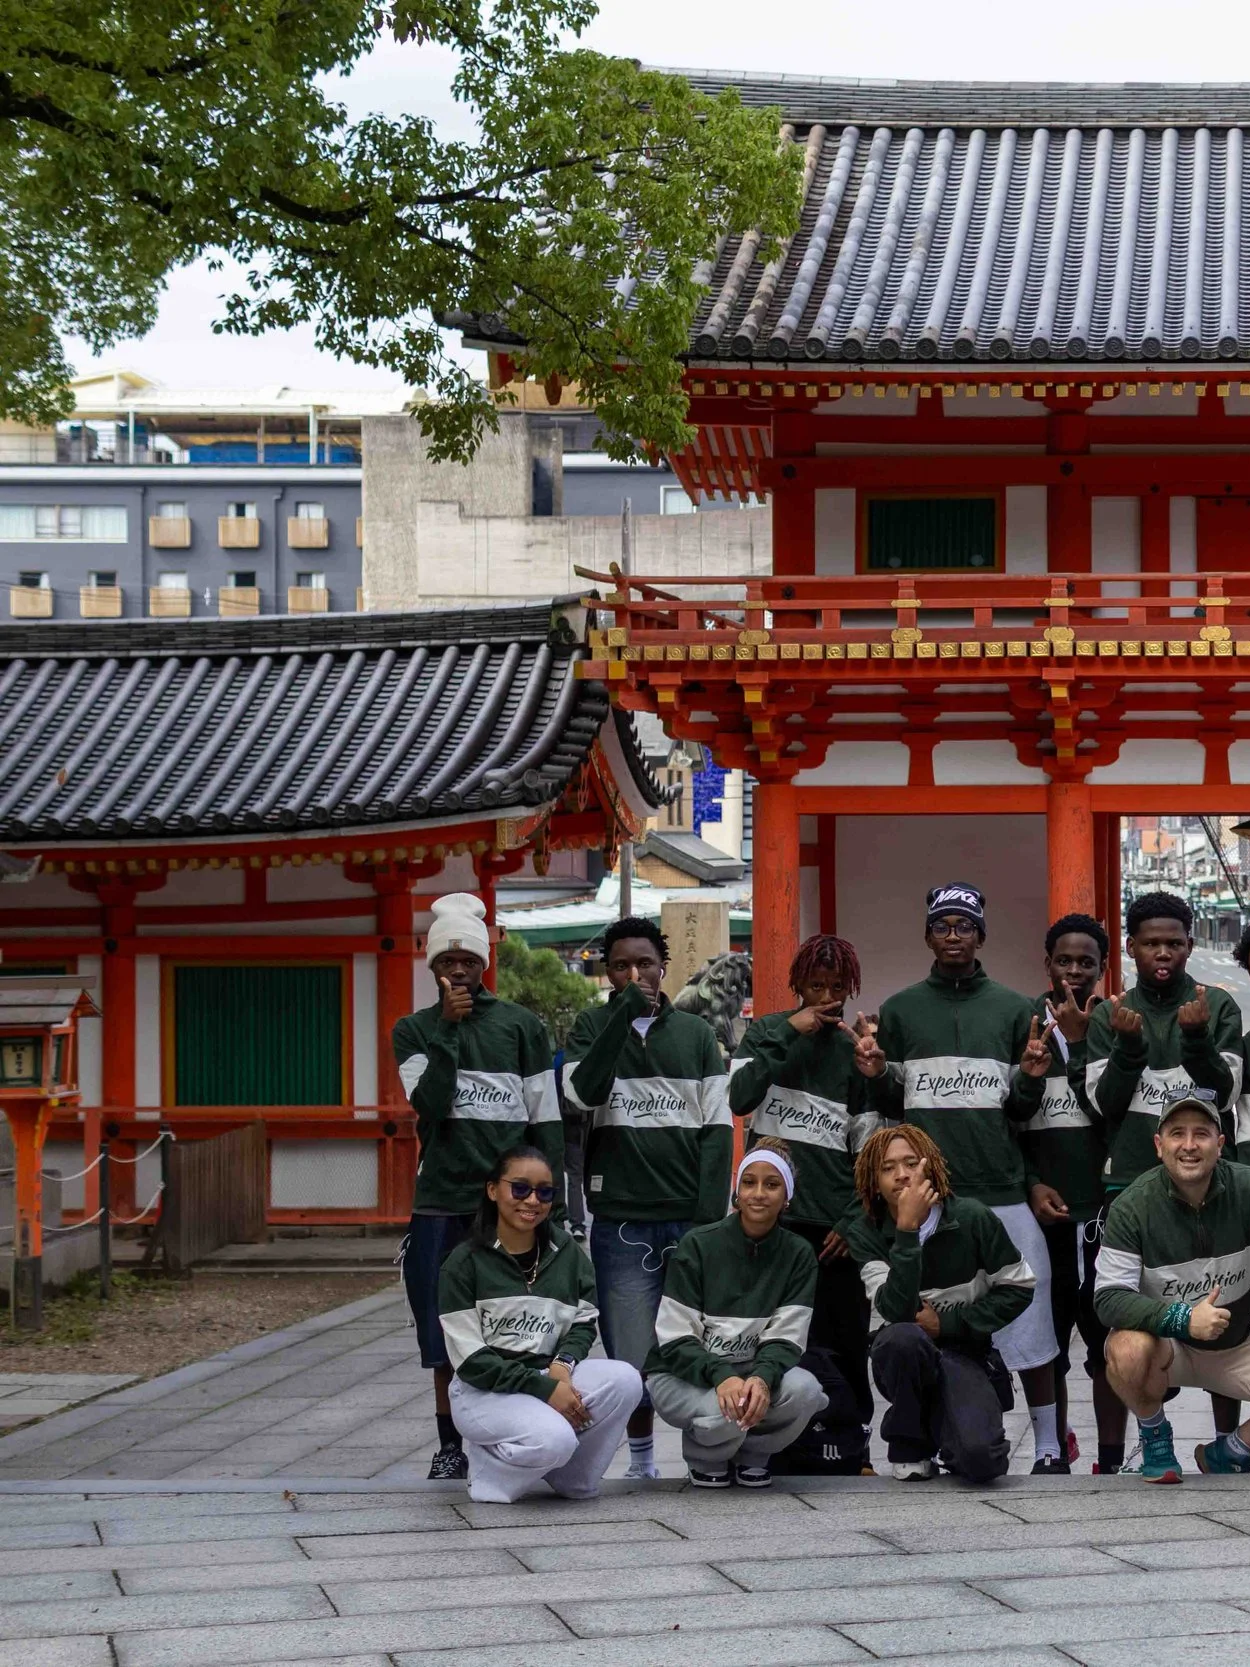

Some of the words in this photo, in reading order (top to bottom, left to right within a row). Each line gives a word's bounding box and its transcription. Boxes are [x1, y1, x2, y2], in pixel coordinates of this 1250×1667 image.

[931, 889, 978, 908] NIKE
[916, 1069, 1001, 1097] Expedition
[609, 1092, 687, 1117] Expedition
[765, 1098, 842, 1133] Expedition
[1161, 1268, 1246, 1302] Expedition
[481, 1307, 555, 1336] Expedition
